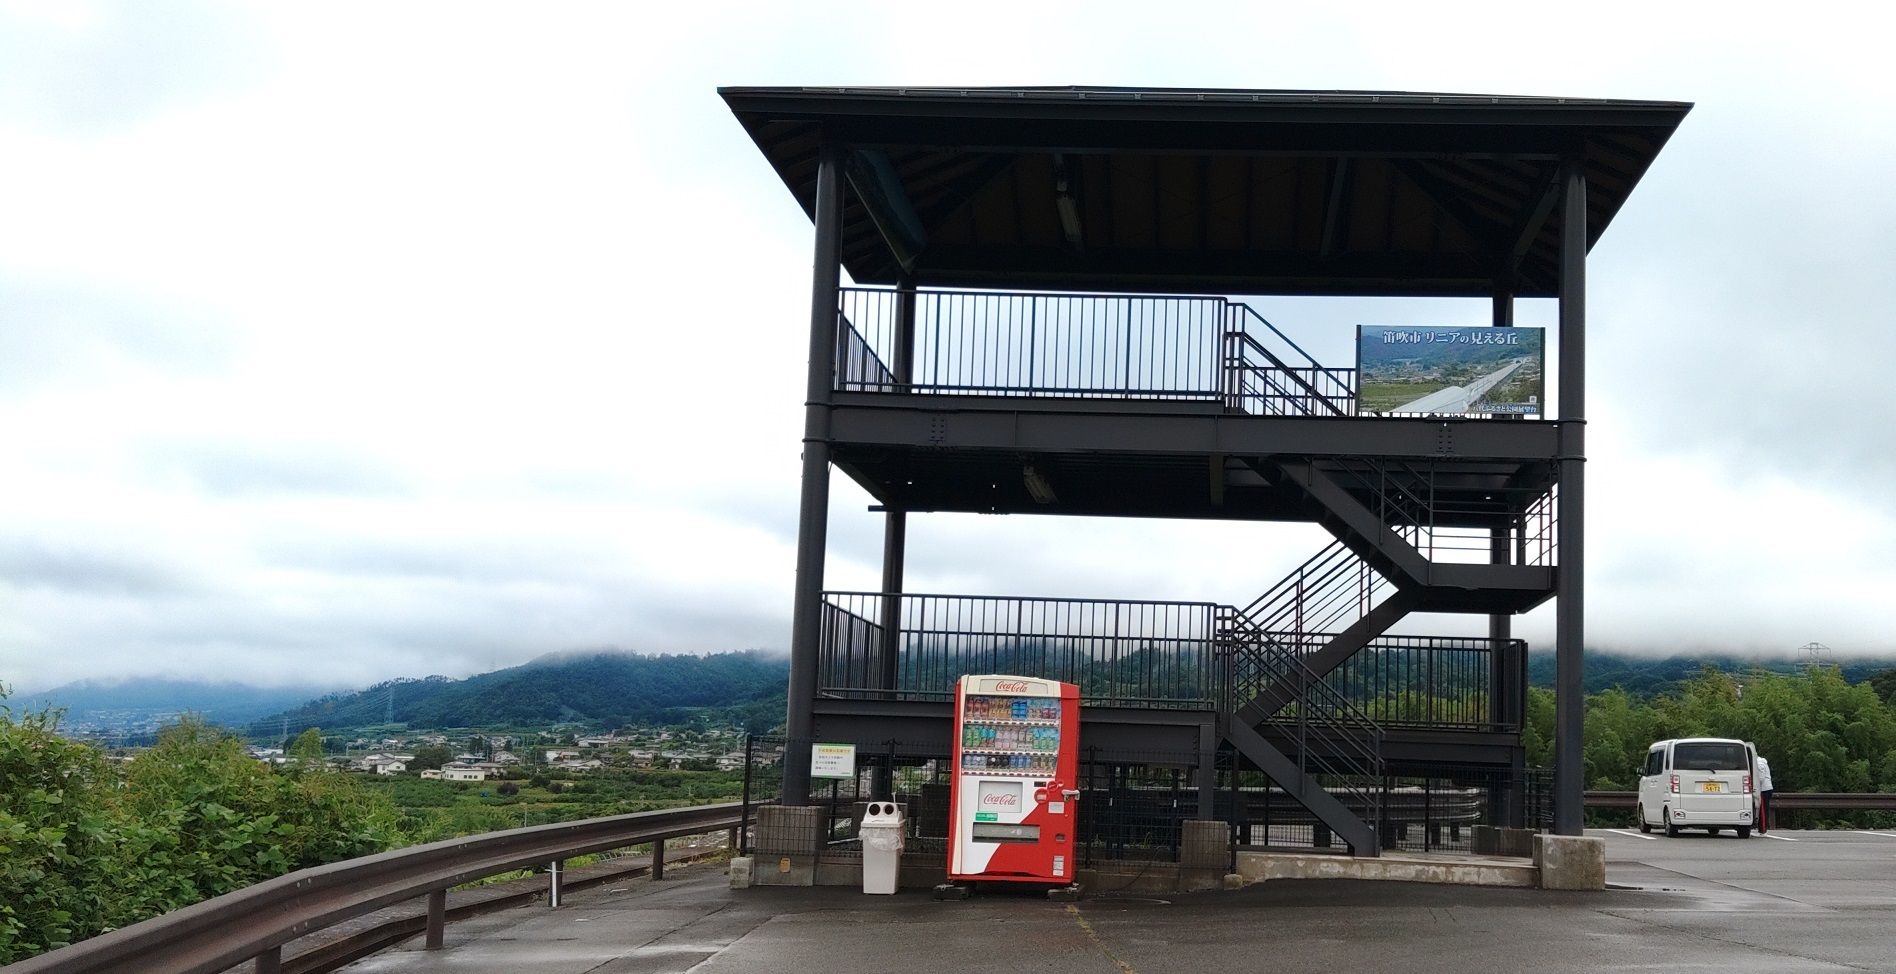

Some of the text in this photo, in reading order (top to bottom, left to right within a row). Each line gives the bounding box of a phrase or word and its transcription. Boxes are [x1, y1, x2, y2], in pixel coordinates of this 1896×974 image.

[1383, 330, 1519, 345] 笛吹市 リニアの見える丘
[995, 680, 1029, 693] Coca-Cola
[983, 793, 1018, 806] Coca-Cola
